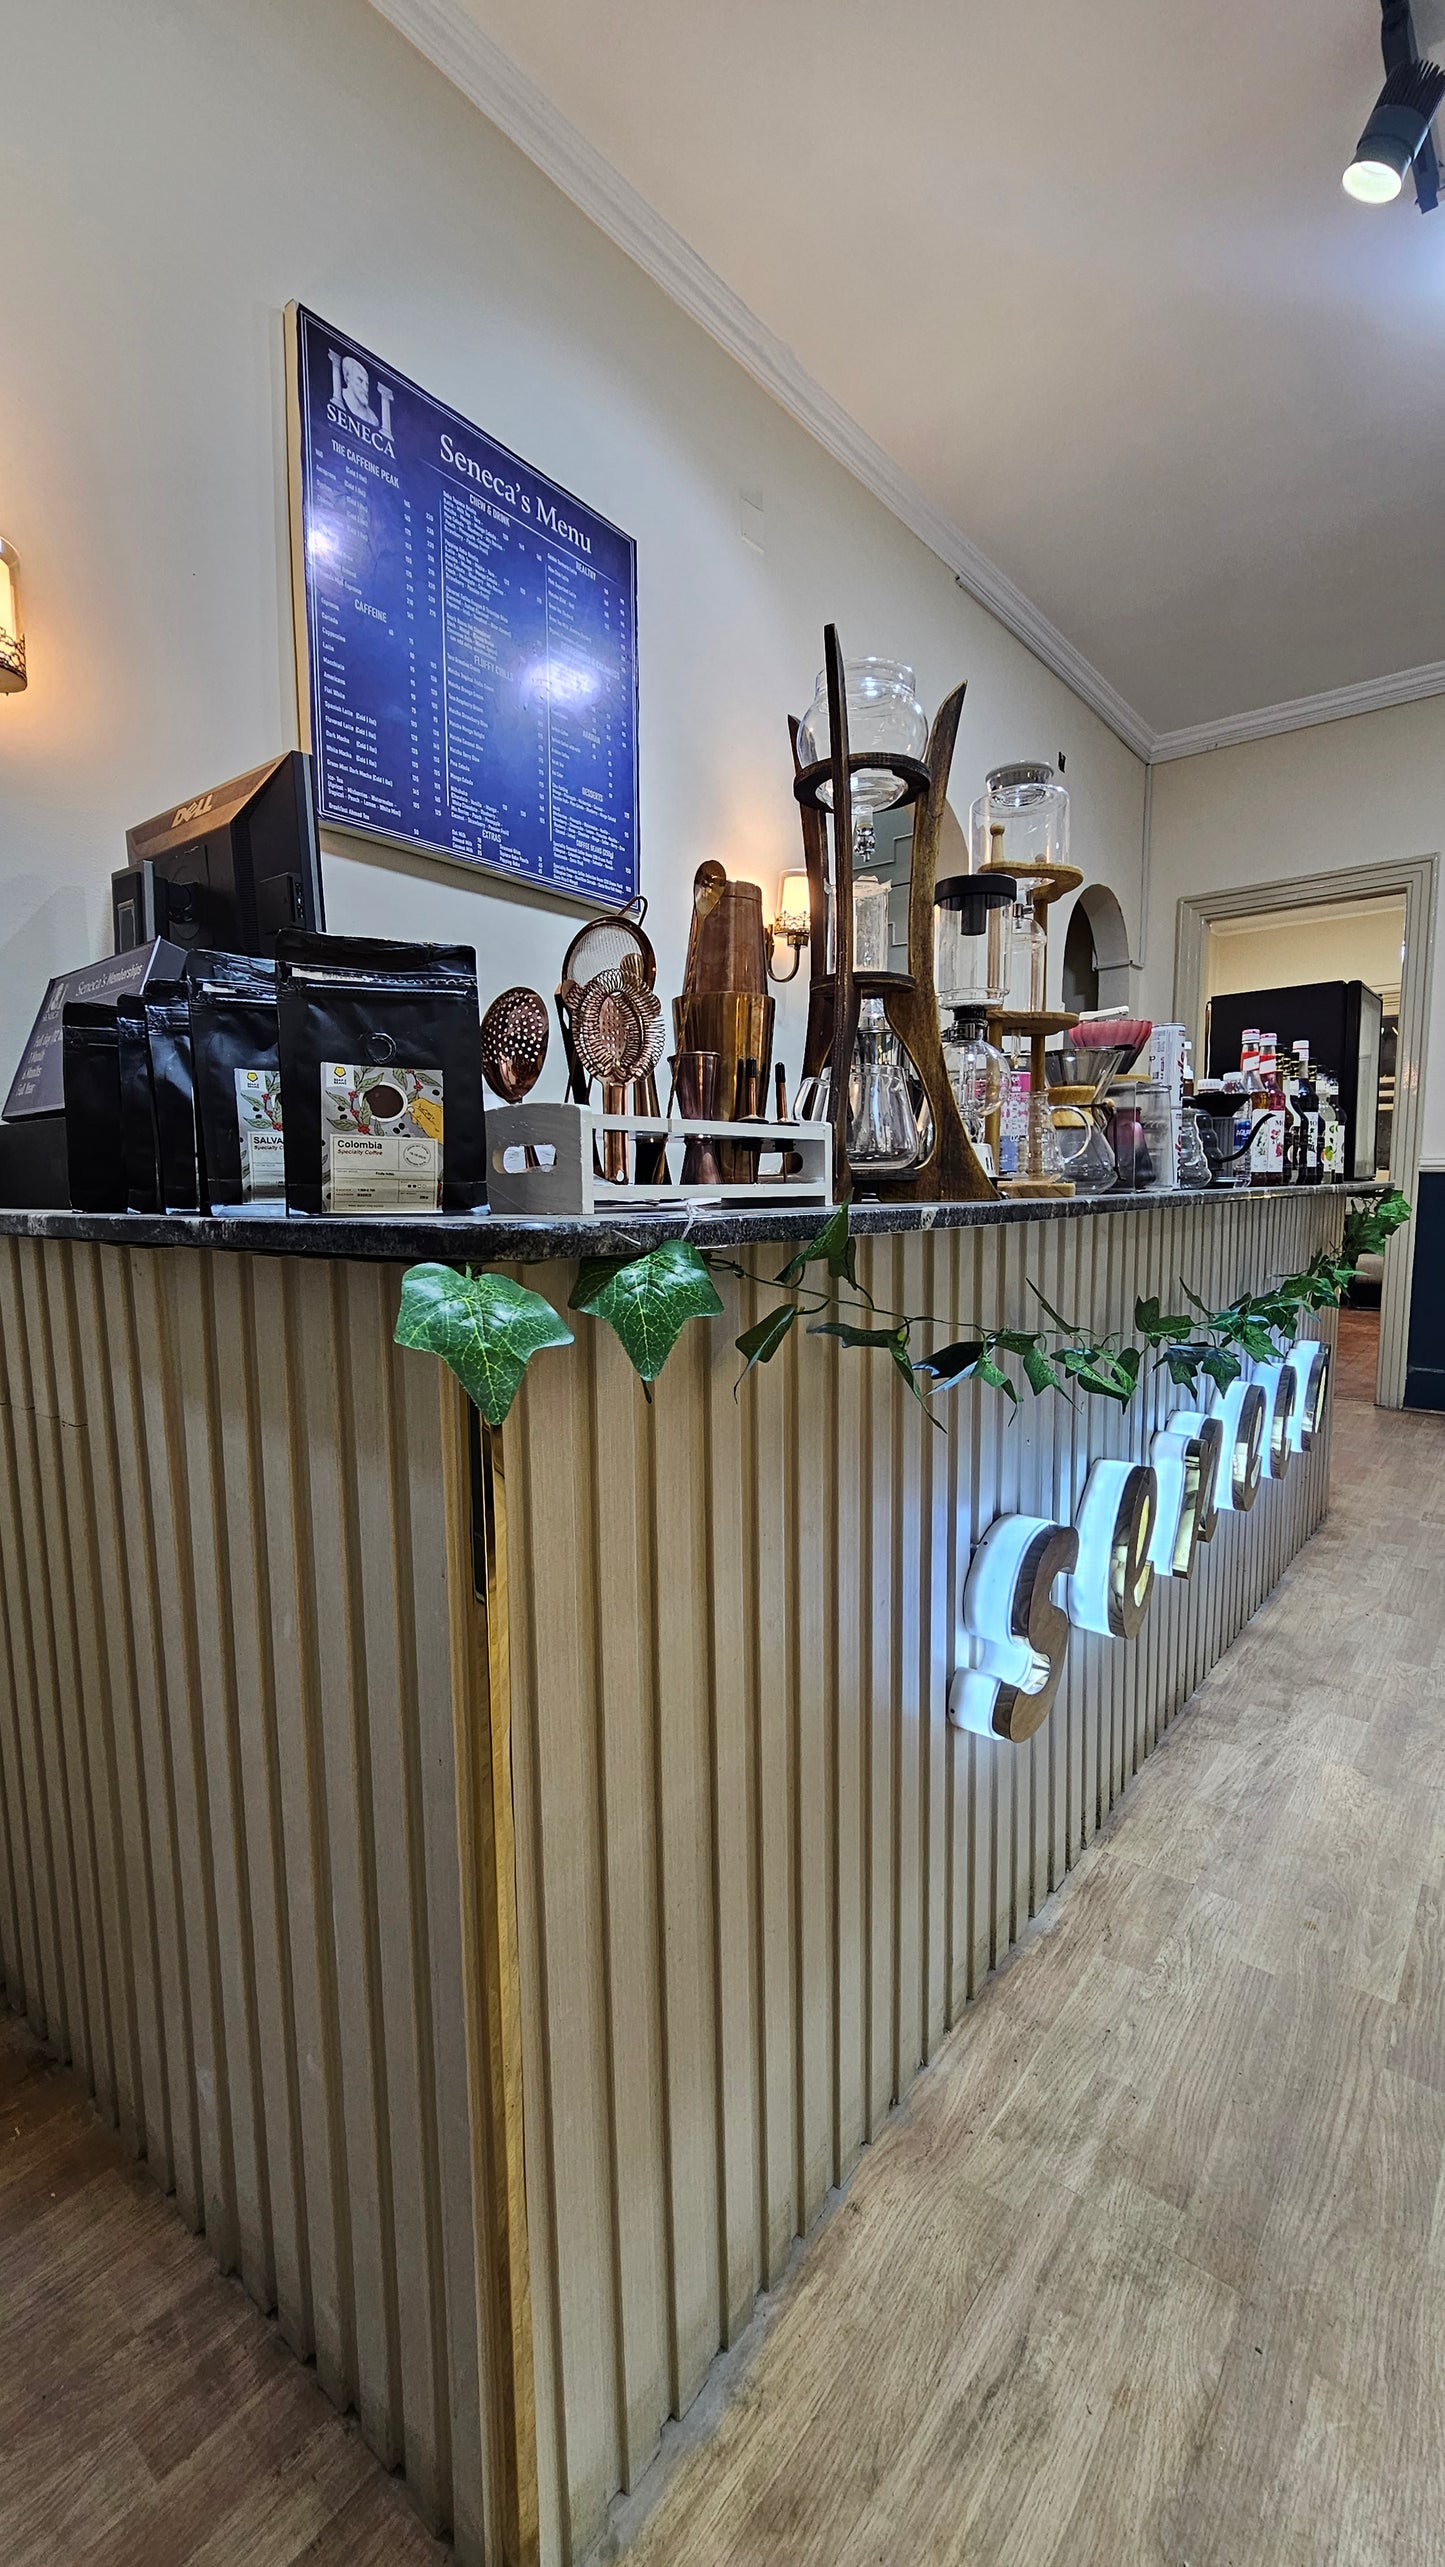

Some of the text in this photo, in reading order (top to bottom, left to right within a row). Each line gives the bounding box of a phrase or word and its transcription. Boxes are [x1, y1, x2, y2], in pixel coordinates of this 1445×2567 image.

[327, 403, 396, 460] SENECA
[331, 439, 399, 488] THE CAFFEINE PEAK
[440, 432, 531, 514] Seneca's
[535, 496, 592, 555] Menu
[469, 494, 486, 512] CHEW
[492, 508, 511, 527] DRINK
[575, 561, 597, 581] HEALTHY
[354, 599, 387, 623] CAFFEINE
[171, 793, 213, 829] DELL
[482, 829, 502, 843] EXTRAS
[338, 1140, 382, 1150] Colombia
[950, 1340, 1332, 1744] Seneca
